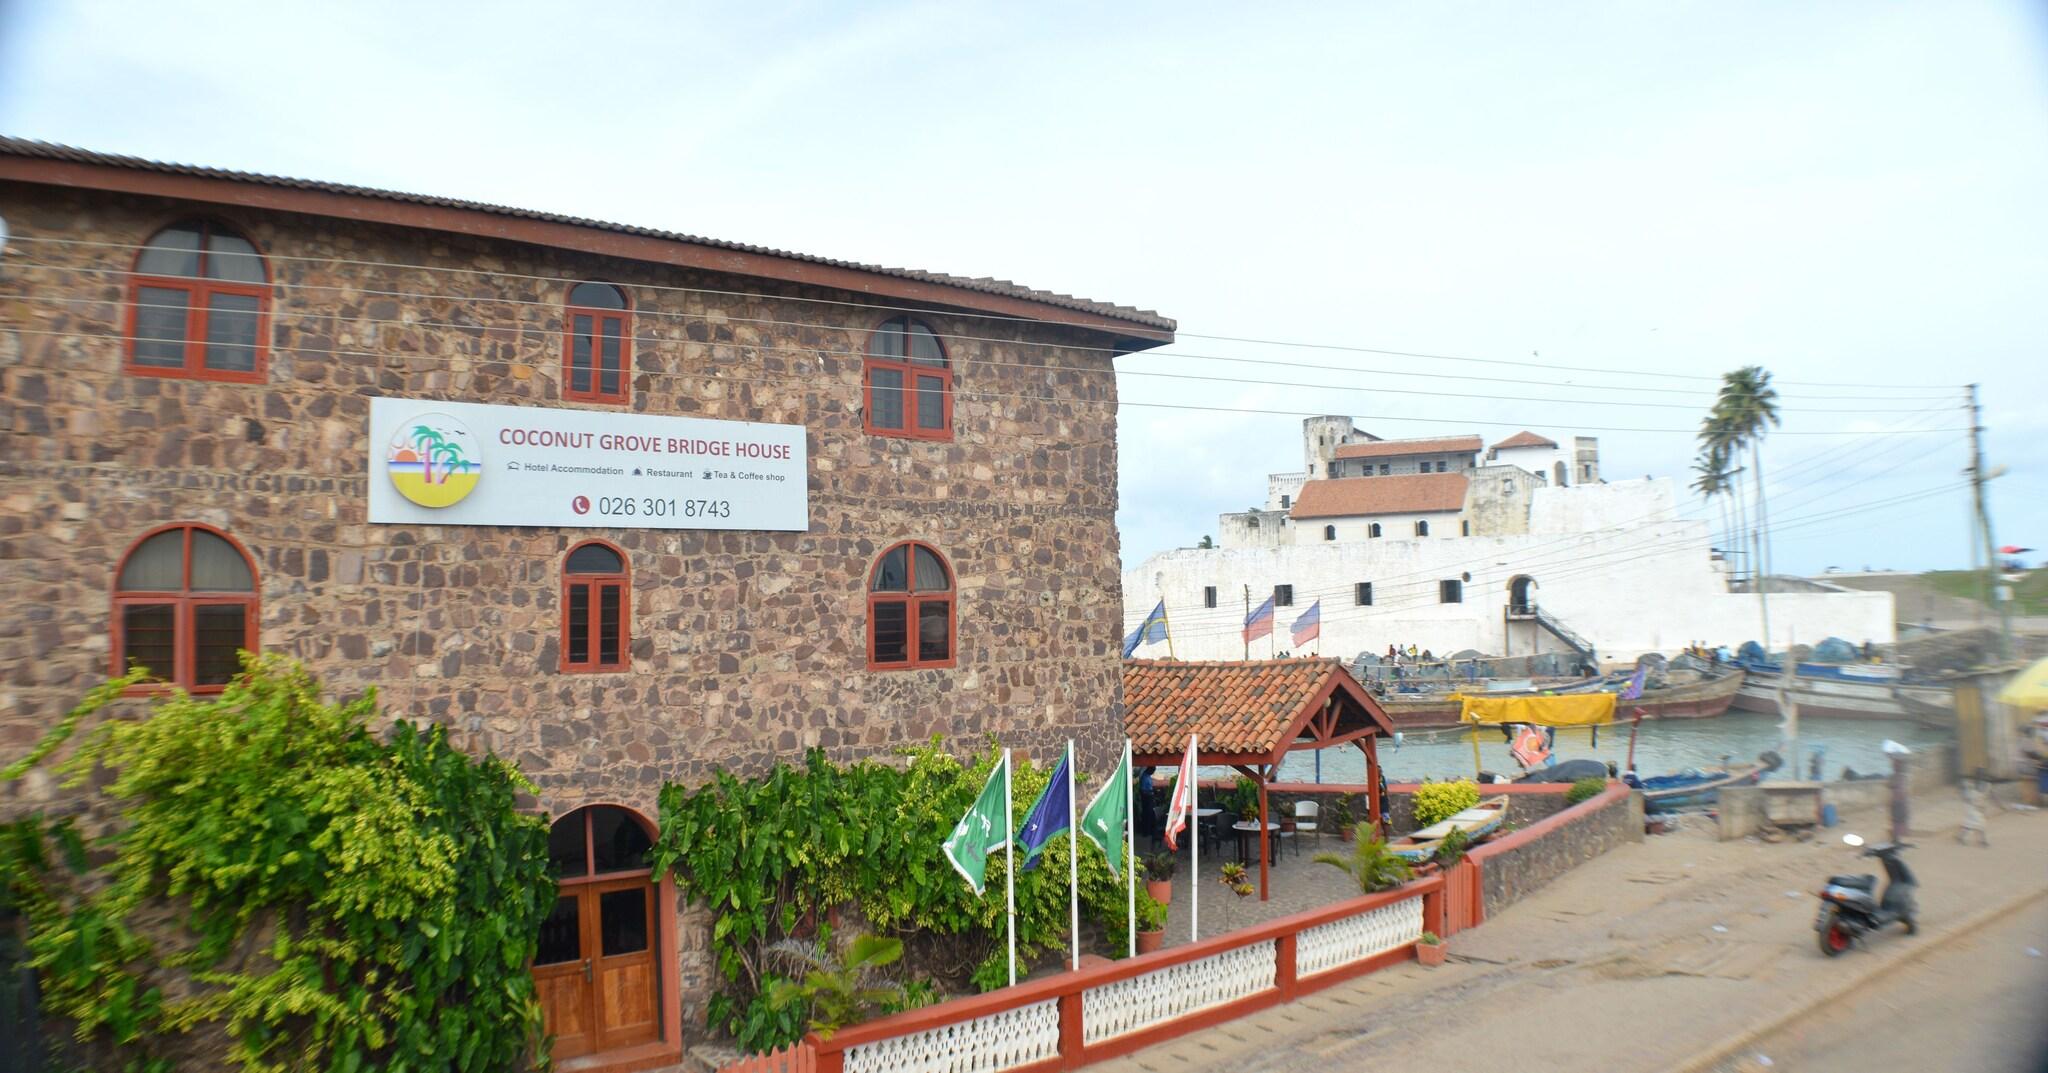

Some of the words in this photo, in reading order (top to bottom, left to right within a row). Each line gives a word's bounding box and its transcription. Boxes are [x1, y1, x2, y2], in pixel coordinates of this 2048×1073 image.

[500, 429, 594, 448] COCONUT
[600, 435, 661, 452] GROVE
[668, 438, 730, 456] BRIDGE
[736, 442, 790, 459] HOUSE
[524, 463, 549, 472] Hotel
[550, 463, 624, 475] Accommodation
[646, 468, 693, 479] Restaurant
[714, 470, 728, 479] Tea
[729, 471, 737, 480] &
[737, 471, 764, 481] Coffee
[765, 473, 786, 483] shop
[599, 497, 635, 515] 026
[643, 498, 675, 516] 301
[685, 500, 730, 518] 8743
